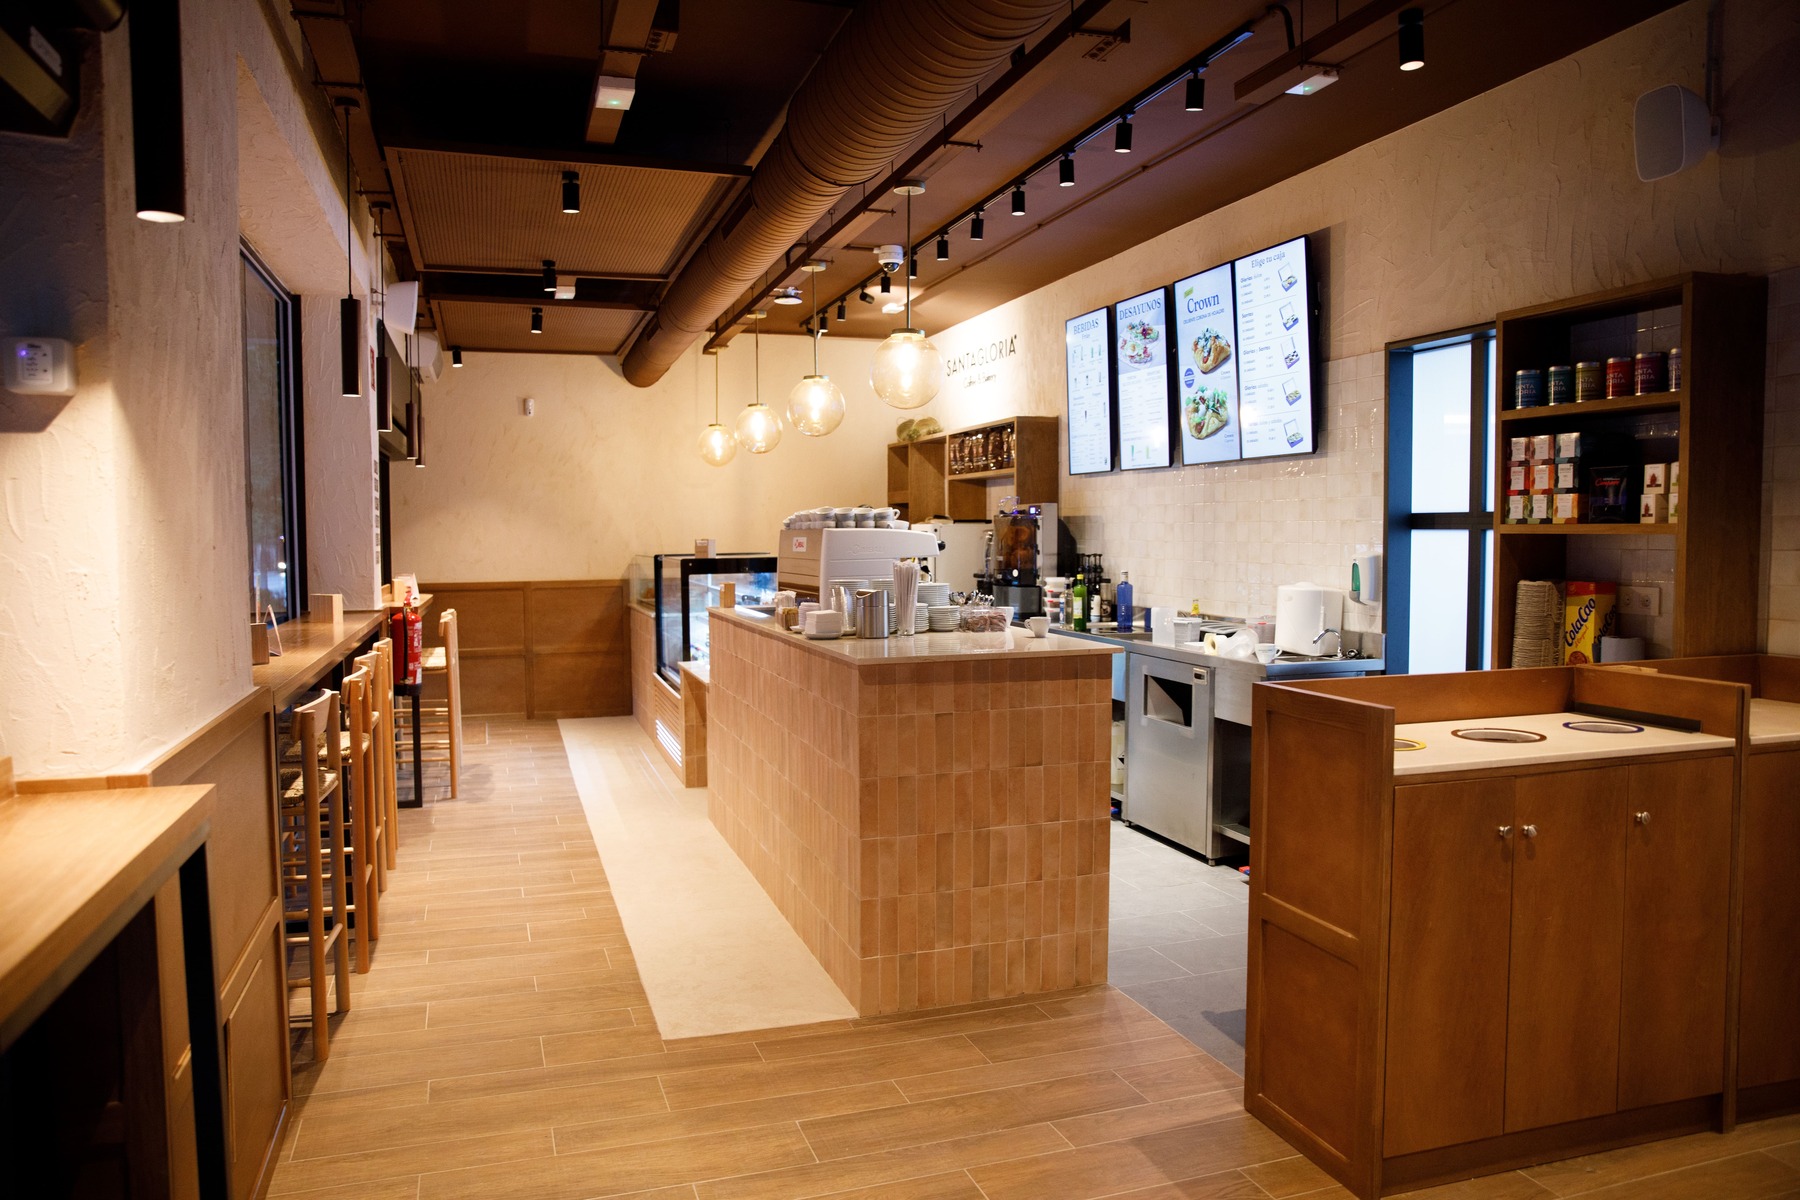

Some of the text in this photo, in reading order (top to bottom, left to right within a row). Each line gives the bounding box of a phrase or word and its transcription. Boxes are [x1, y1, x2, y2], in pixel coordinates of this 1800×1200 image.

[1119, 297, 1162, 320] DESAYUNOS
[1187, 294, 1220, 314] Crown
[1073, 318, 1099, 335] BEBIDAS
[1565, 597, 1596, 647] ColaCao
